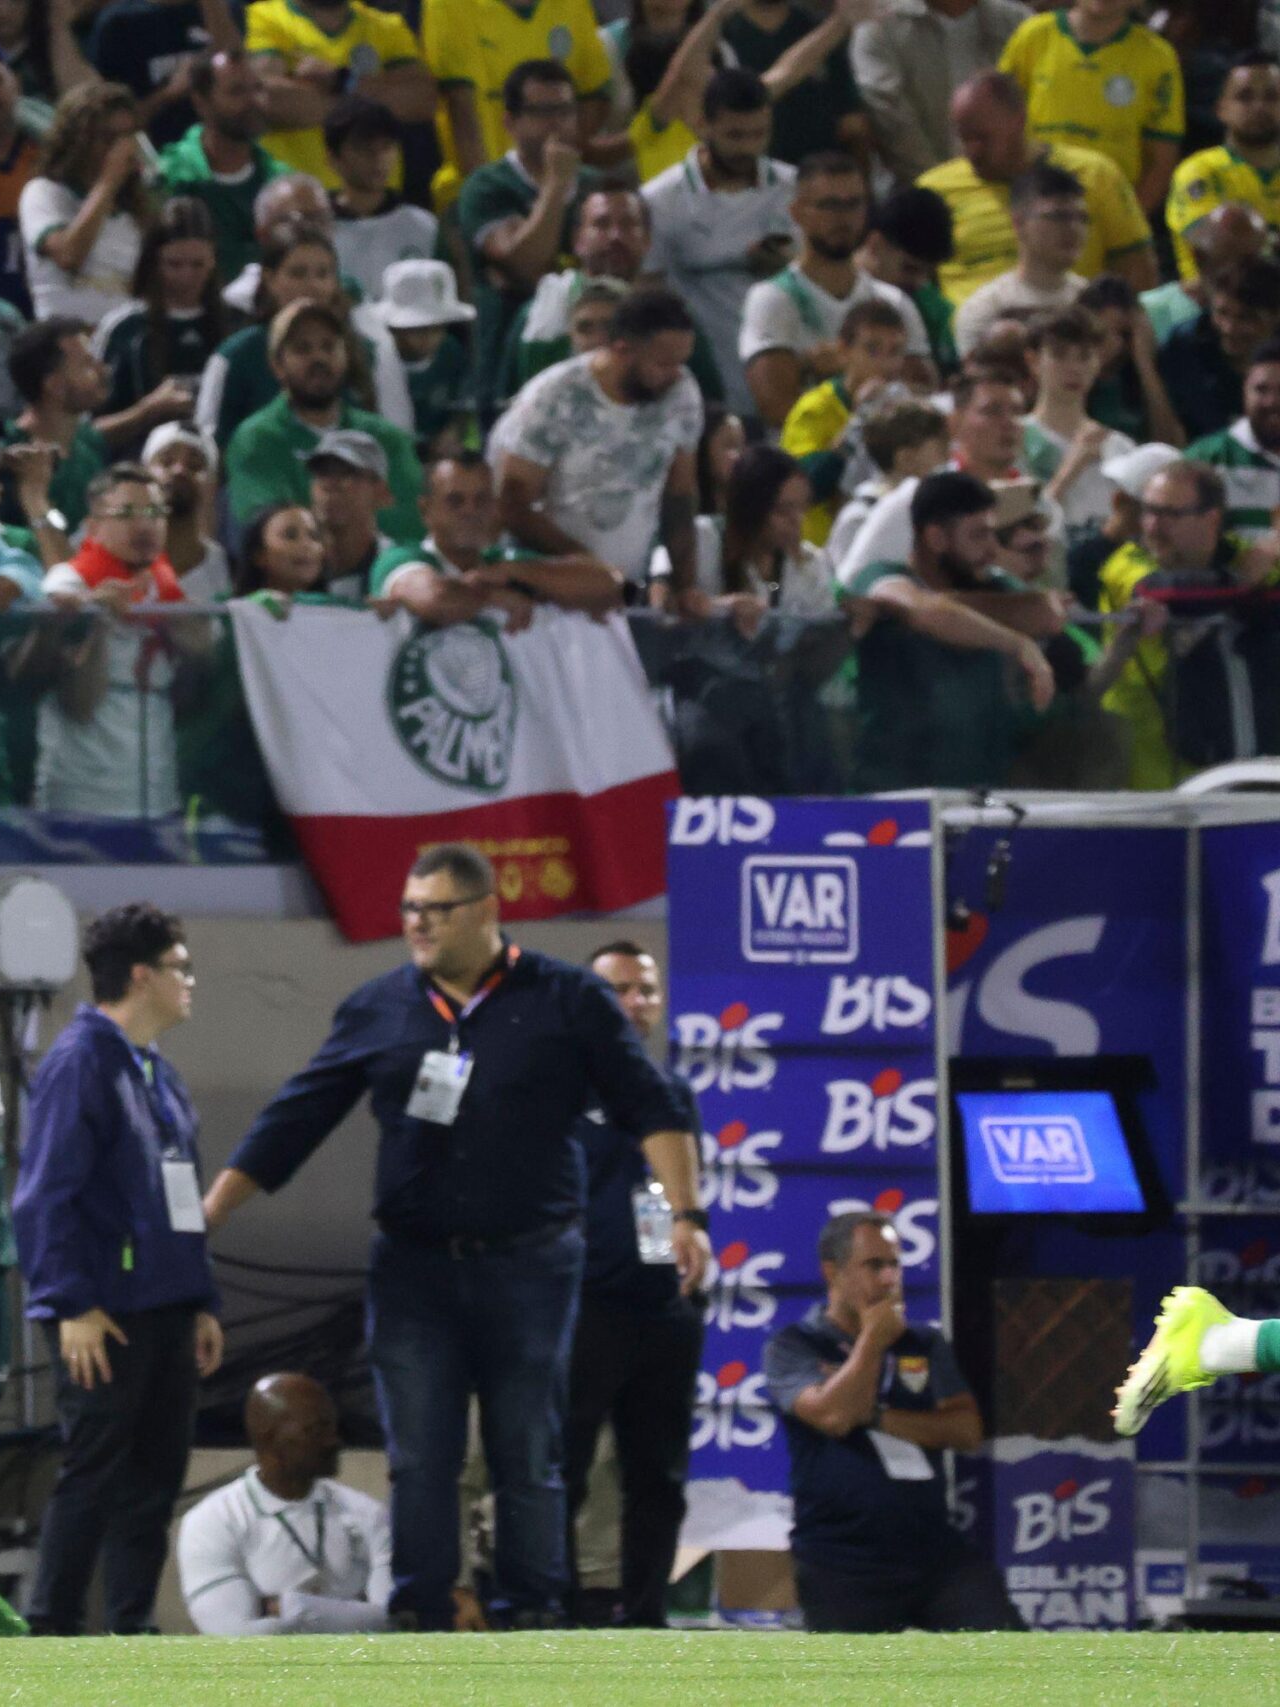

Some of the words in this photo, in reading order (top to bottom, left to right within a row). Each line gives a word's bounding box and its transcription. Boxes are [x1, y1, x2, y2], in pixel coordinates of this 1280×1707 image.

[753, 872, 846, 929] VAR
[991, 1125, 1079, 1164] VAR
[1006, 1565, 1127, 1591] BILHO
[1009, 1592, 1129, 1625] TAN
